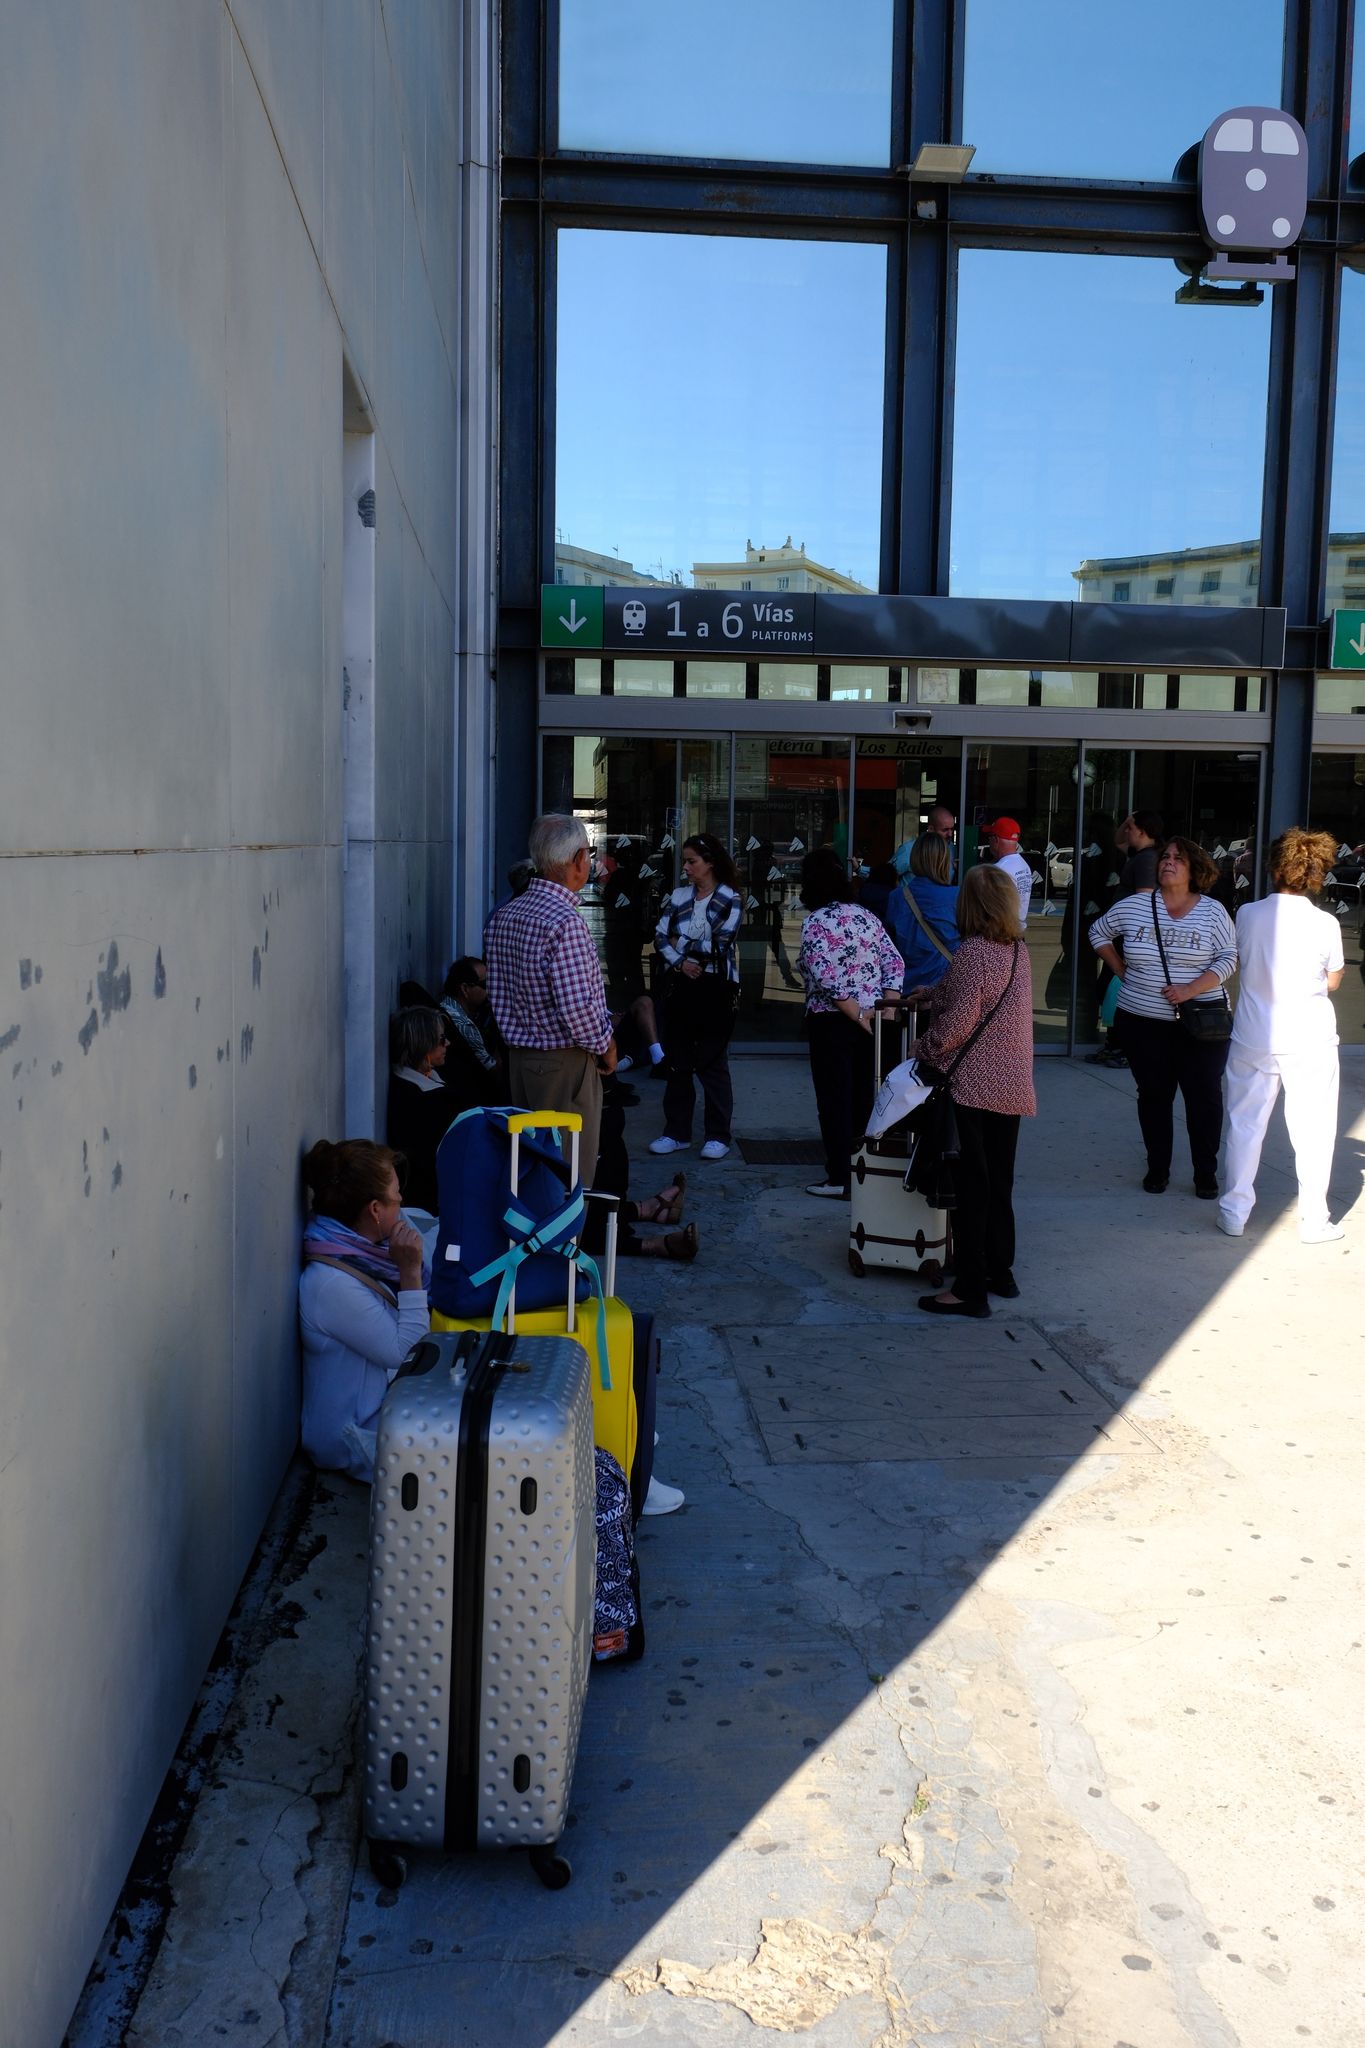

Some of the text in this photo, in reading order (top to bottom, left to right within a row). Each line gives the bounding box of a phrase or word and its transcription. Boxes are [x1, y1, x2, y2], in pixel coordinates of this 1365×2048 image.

[667, 600, 794, 638] 1 a 6 Vías
[751, 630, 814, 642] PLATFORMS
[857, 740, 943, 755] Los Railes
